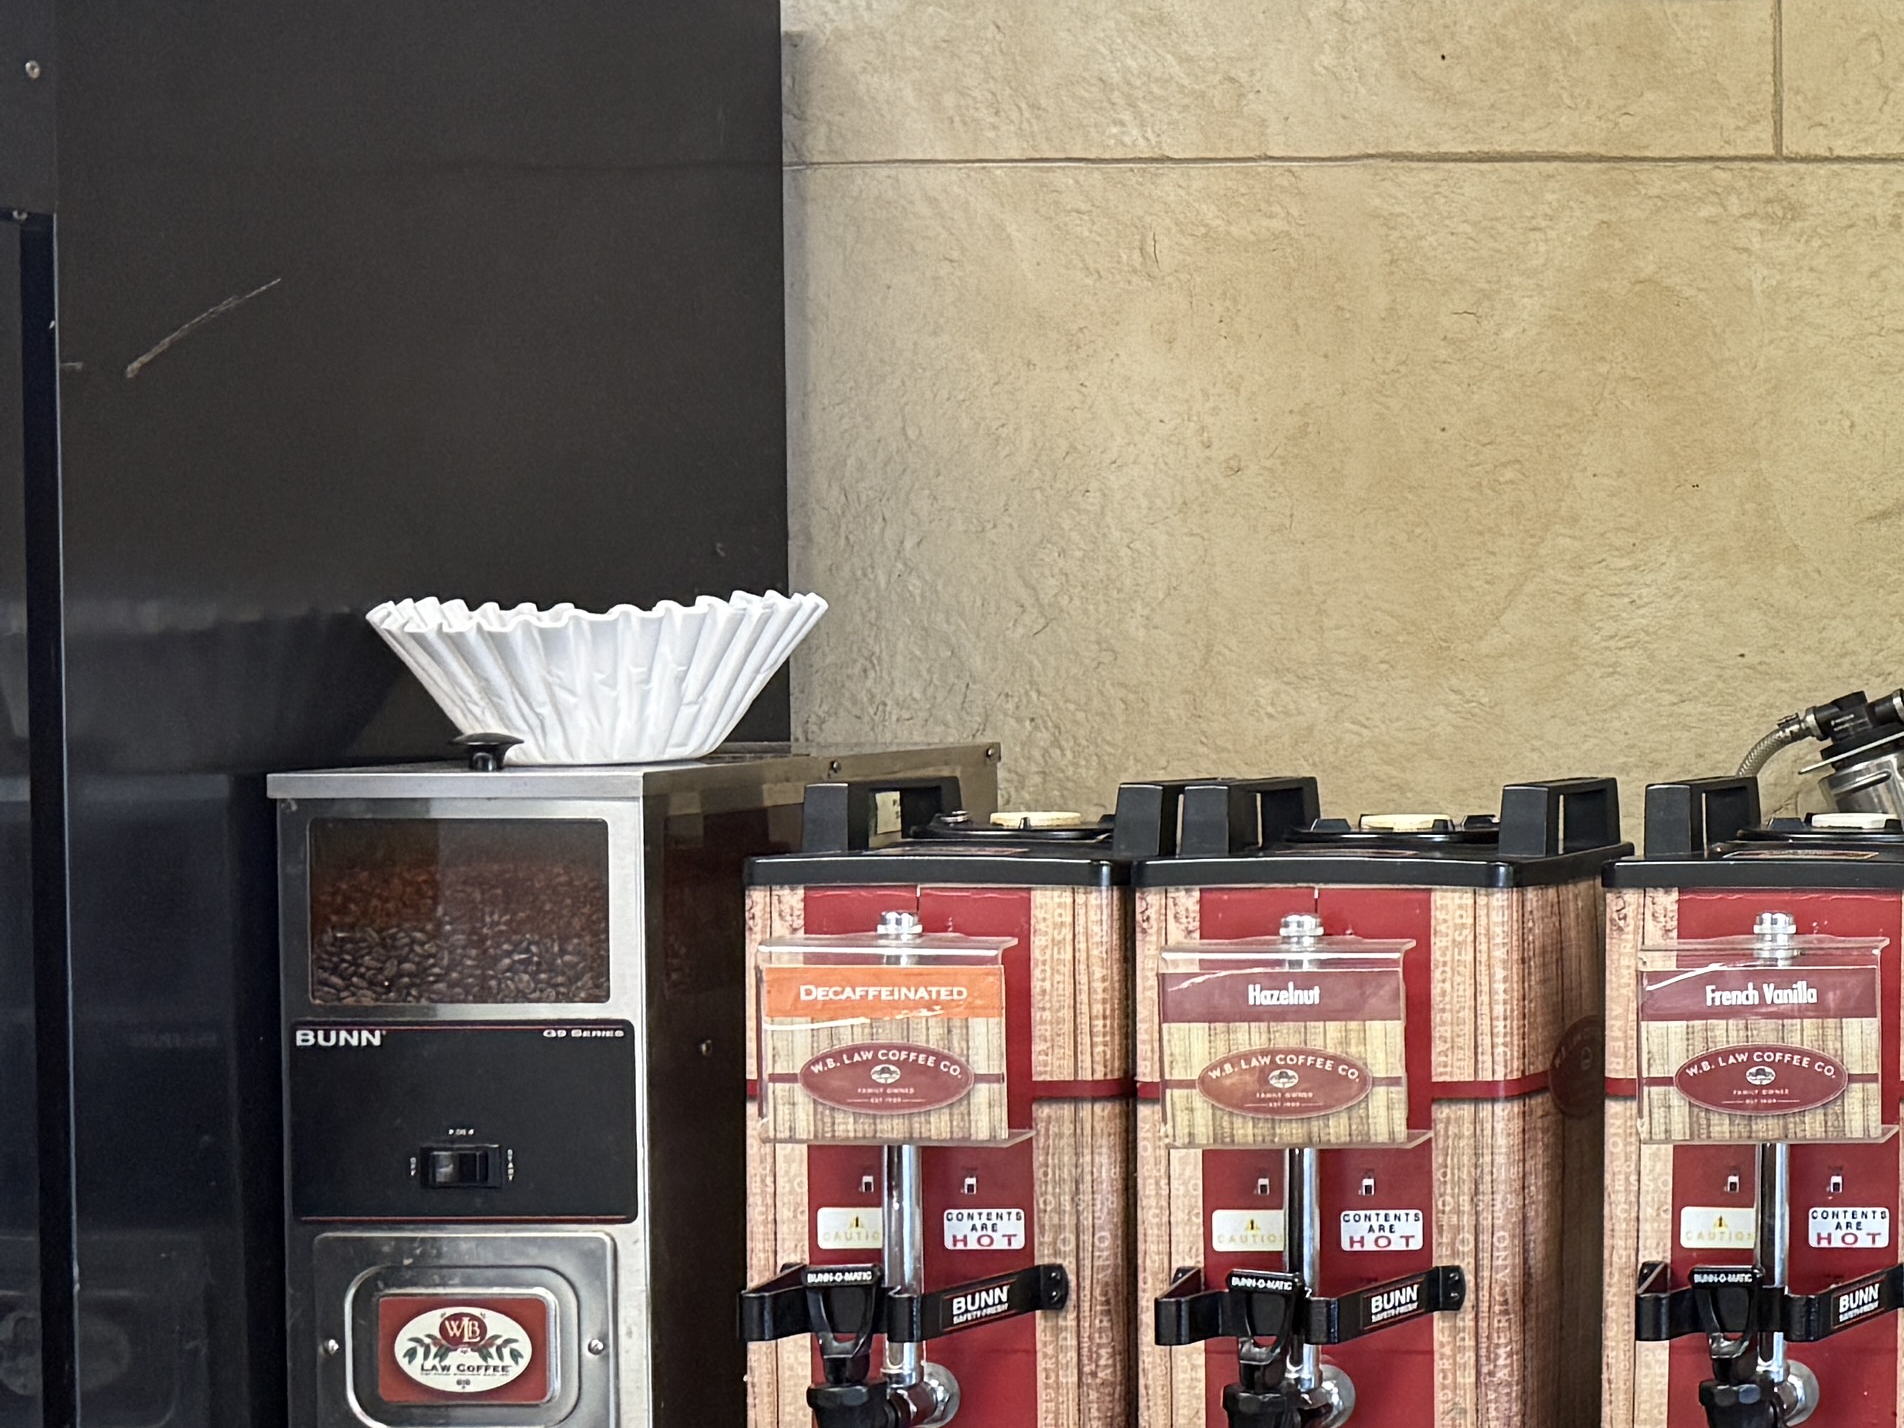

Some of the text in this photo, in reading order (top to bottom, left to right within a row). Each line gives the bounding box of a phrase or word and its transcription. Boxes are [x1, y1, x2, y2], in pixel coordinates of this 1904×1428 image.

[800, 985, 968, 1000] DECAFFEINATED
[1248, 982, 1320, 1006] Hazelnut
[1706, 980, 1817, 1007] French Vanilla
[295, 1030, 382, 1047] BUNN
[811, 1050, 962, 1079] W.B. LAW COFFEE CO.
[946, 1211, 1022, 1221] CONTENTS
[971, 1223, 998, 1232] ARE
[952, 1234, 1018, 1247] HOT
[807, 1272, 872, 1283] BUNN-O-MATIC
[952, 1286, 1009, 1315] BUNN
[421, 1363, 510, 1373] LAW COFFEE
